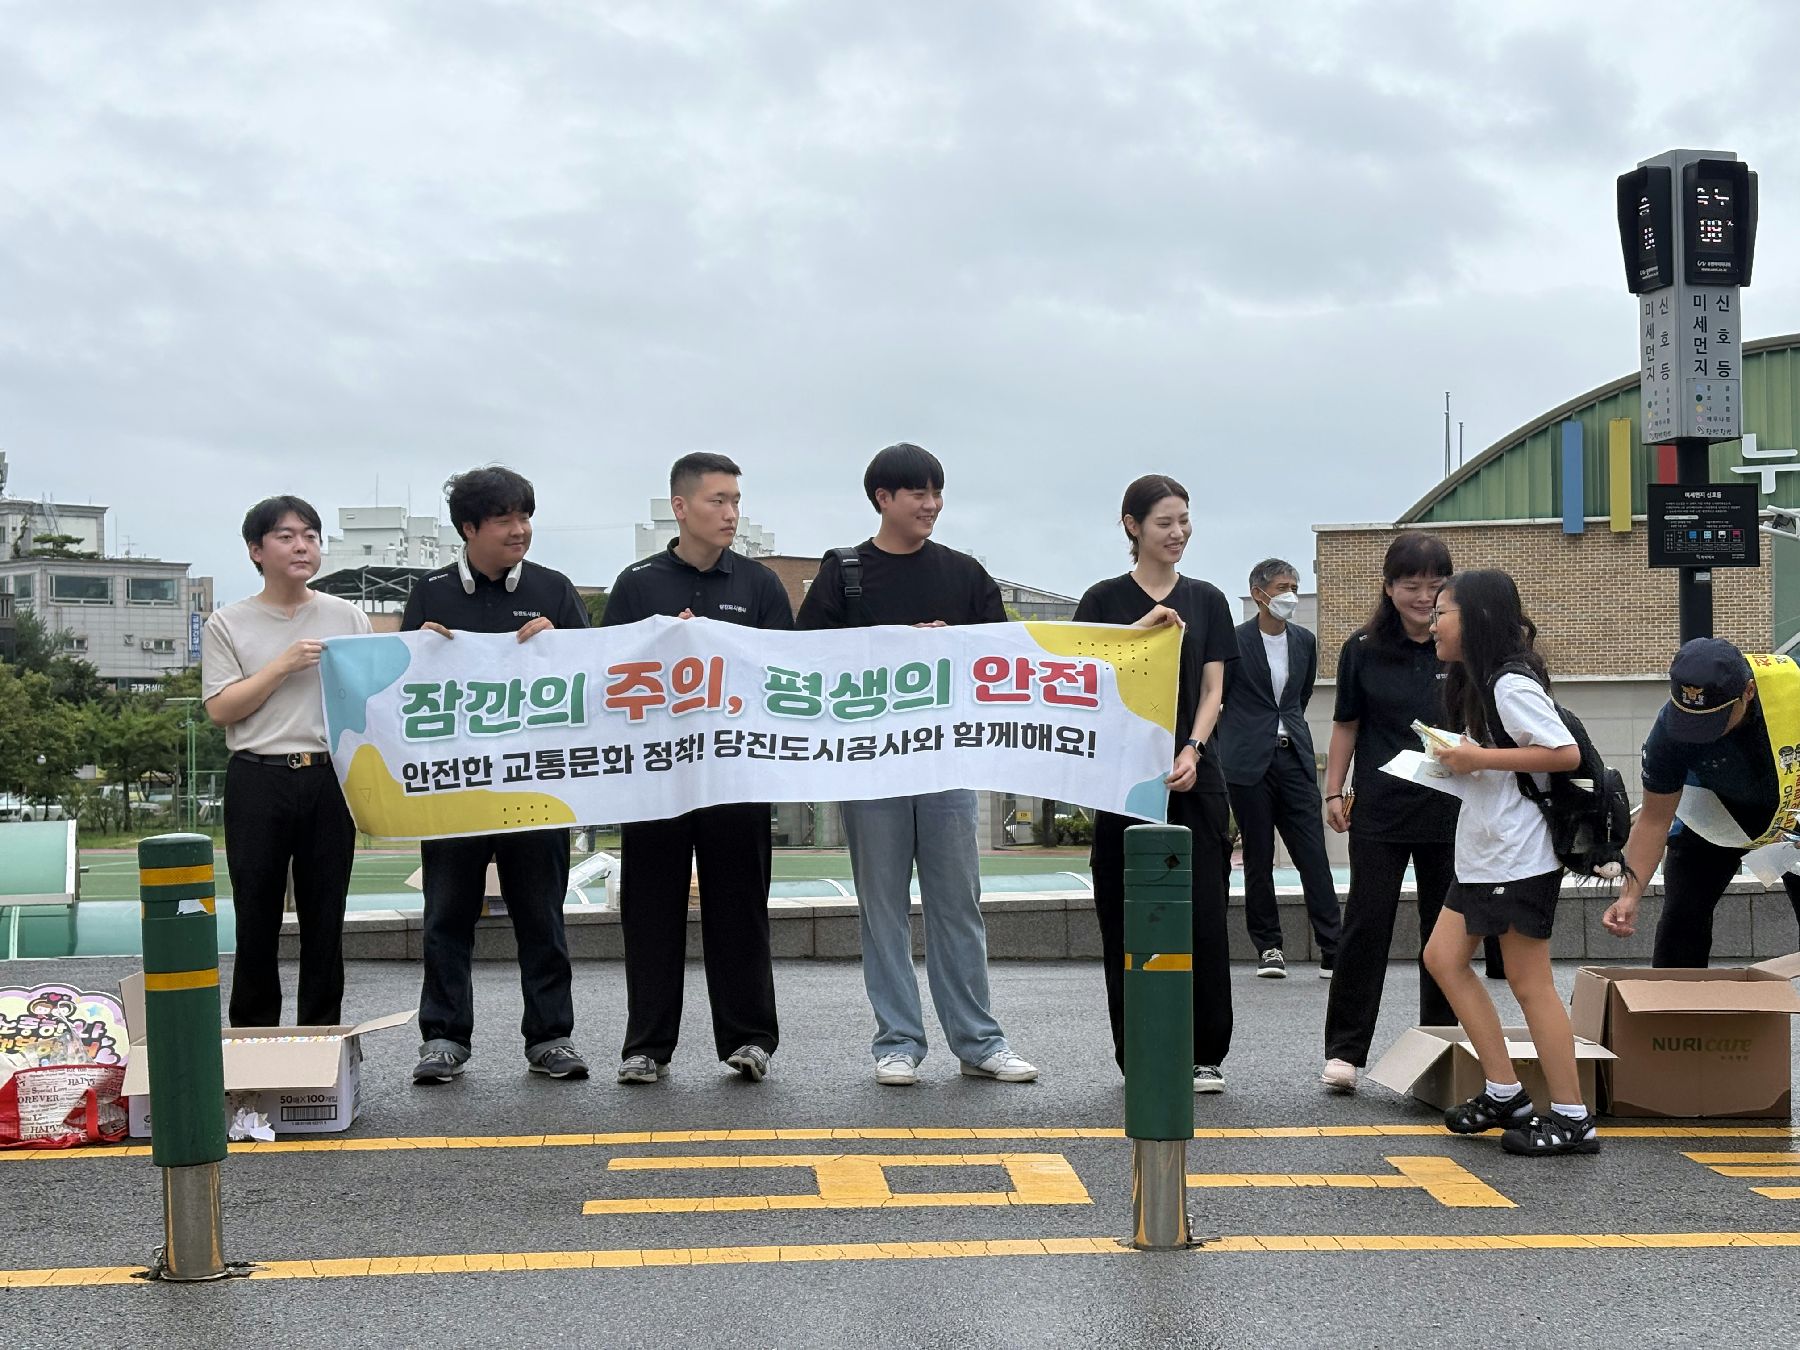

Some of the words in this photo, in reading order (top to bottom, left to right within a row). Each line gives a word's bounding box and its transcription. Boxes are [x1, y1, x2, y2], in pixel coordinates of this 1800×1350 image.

[1693, 294, 1708, 376] 미세먼지
[1716, 294, 1732, 378] 신호등
[403, 673, 586, 739] 잠깐의
[606, 655, 743, 721] 주의,
[764, 658, 951, 720] 평생의
[973, 656, 1099, 708] 안전
[402, 755, 493, 793] 안전한
[502, 744, 634, 783] 교통문화
[643, 733, 704, 772] 정착!
[714, 729, 944, 762] 당진도시공사와
[953, 721, 1096, 758] 함께해요!
